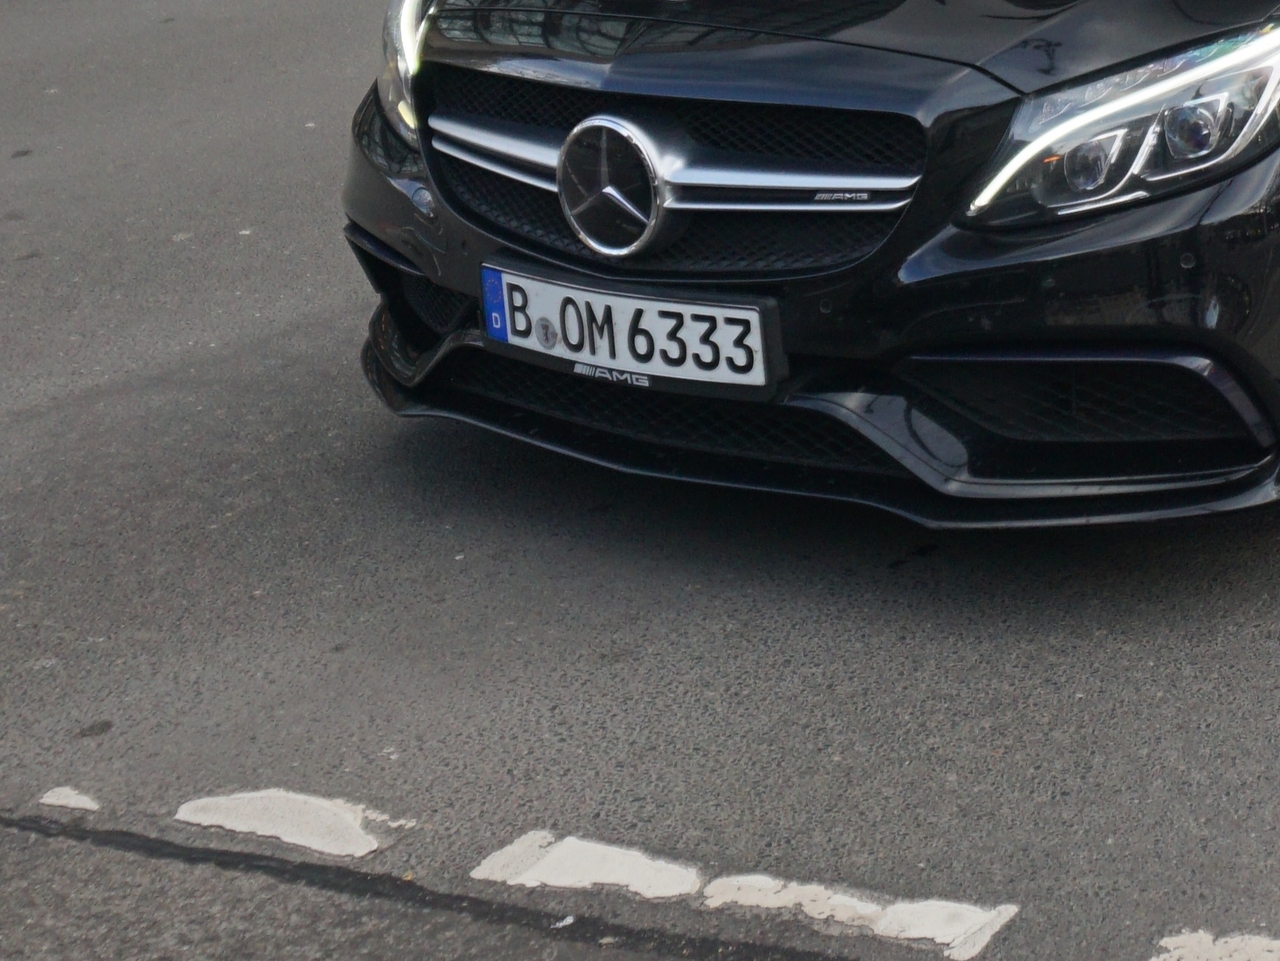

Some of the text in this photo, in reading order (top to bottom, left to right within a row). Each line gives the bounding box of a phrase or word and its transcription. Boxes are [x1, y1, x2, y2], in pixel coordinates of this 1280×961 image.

[491, 282, 754, 374] D B OM 6333
[594, 368, 650, 387] AMG
